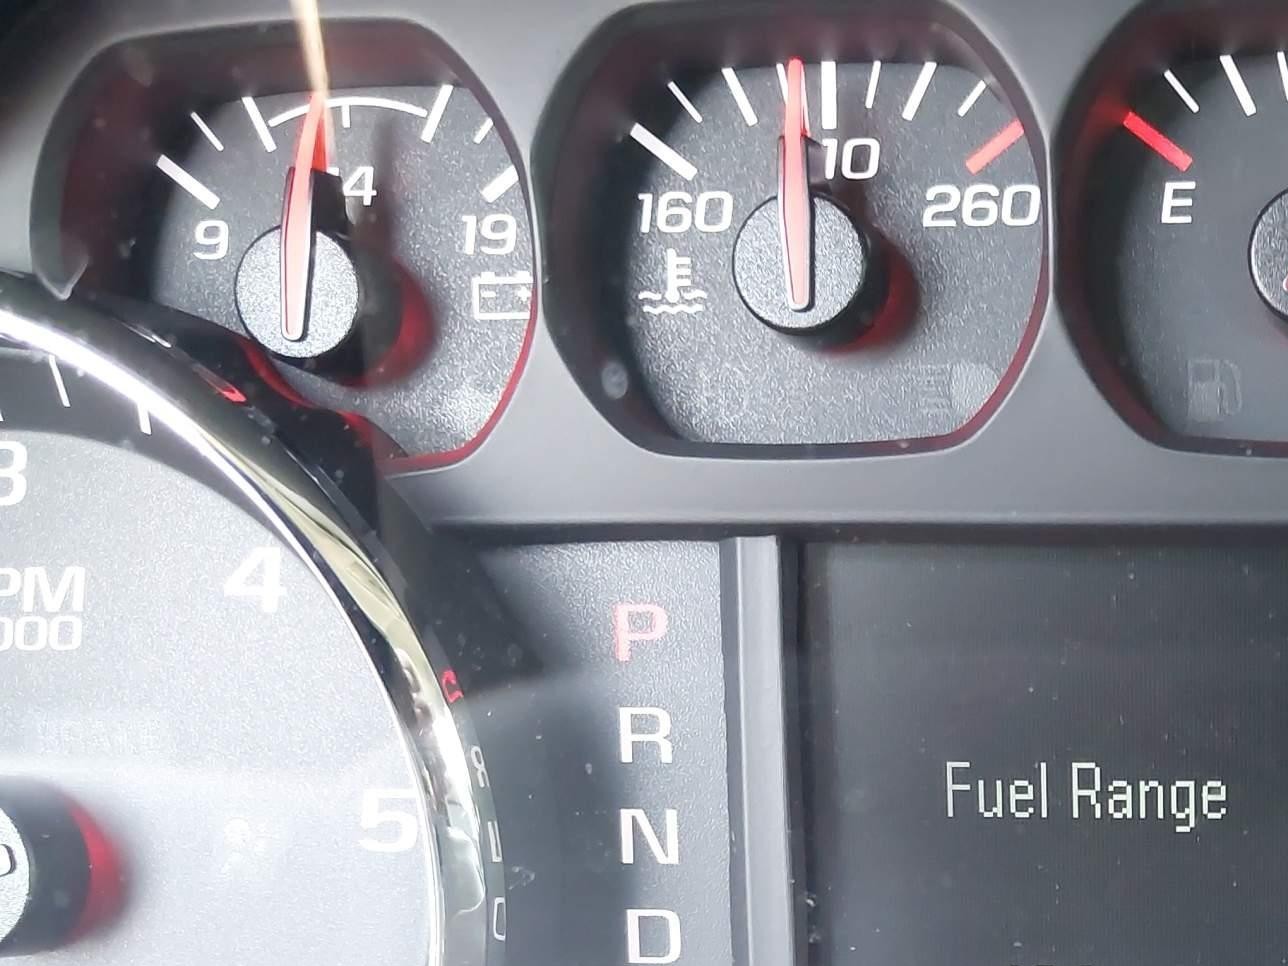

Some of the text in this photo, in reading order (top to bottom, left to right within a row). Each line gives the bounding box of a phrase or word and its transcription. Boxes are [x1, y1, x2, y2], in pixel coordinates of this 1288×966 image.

[326, 166, 378, 206] 4
[638, 190, 734, 234] 160
[923, 183, 1040, 227] 260
[1162, 181, 1196, 223] E
[194, 220, 228, 259] 9
[462, 214, 516, 257] 19
[223, 546, 287, 613] 4
[612, 602, 667, 662] P
[619, 706, 673, 764] R
[357, 788, 420, 853] 5
[947, 762, 1226, 832] Fuel Range
[620, 807, 681, 865] N
[627, 909, 681, 964] D
